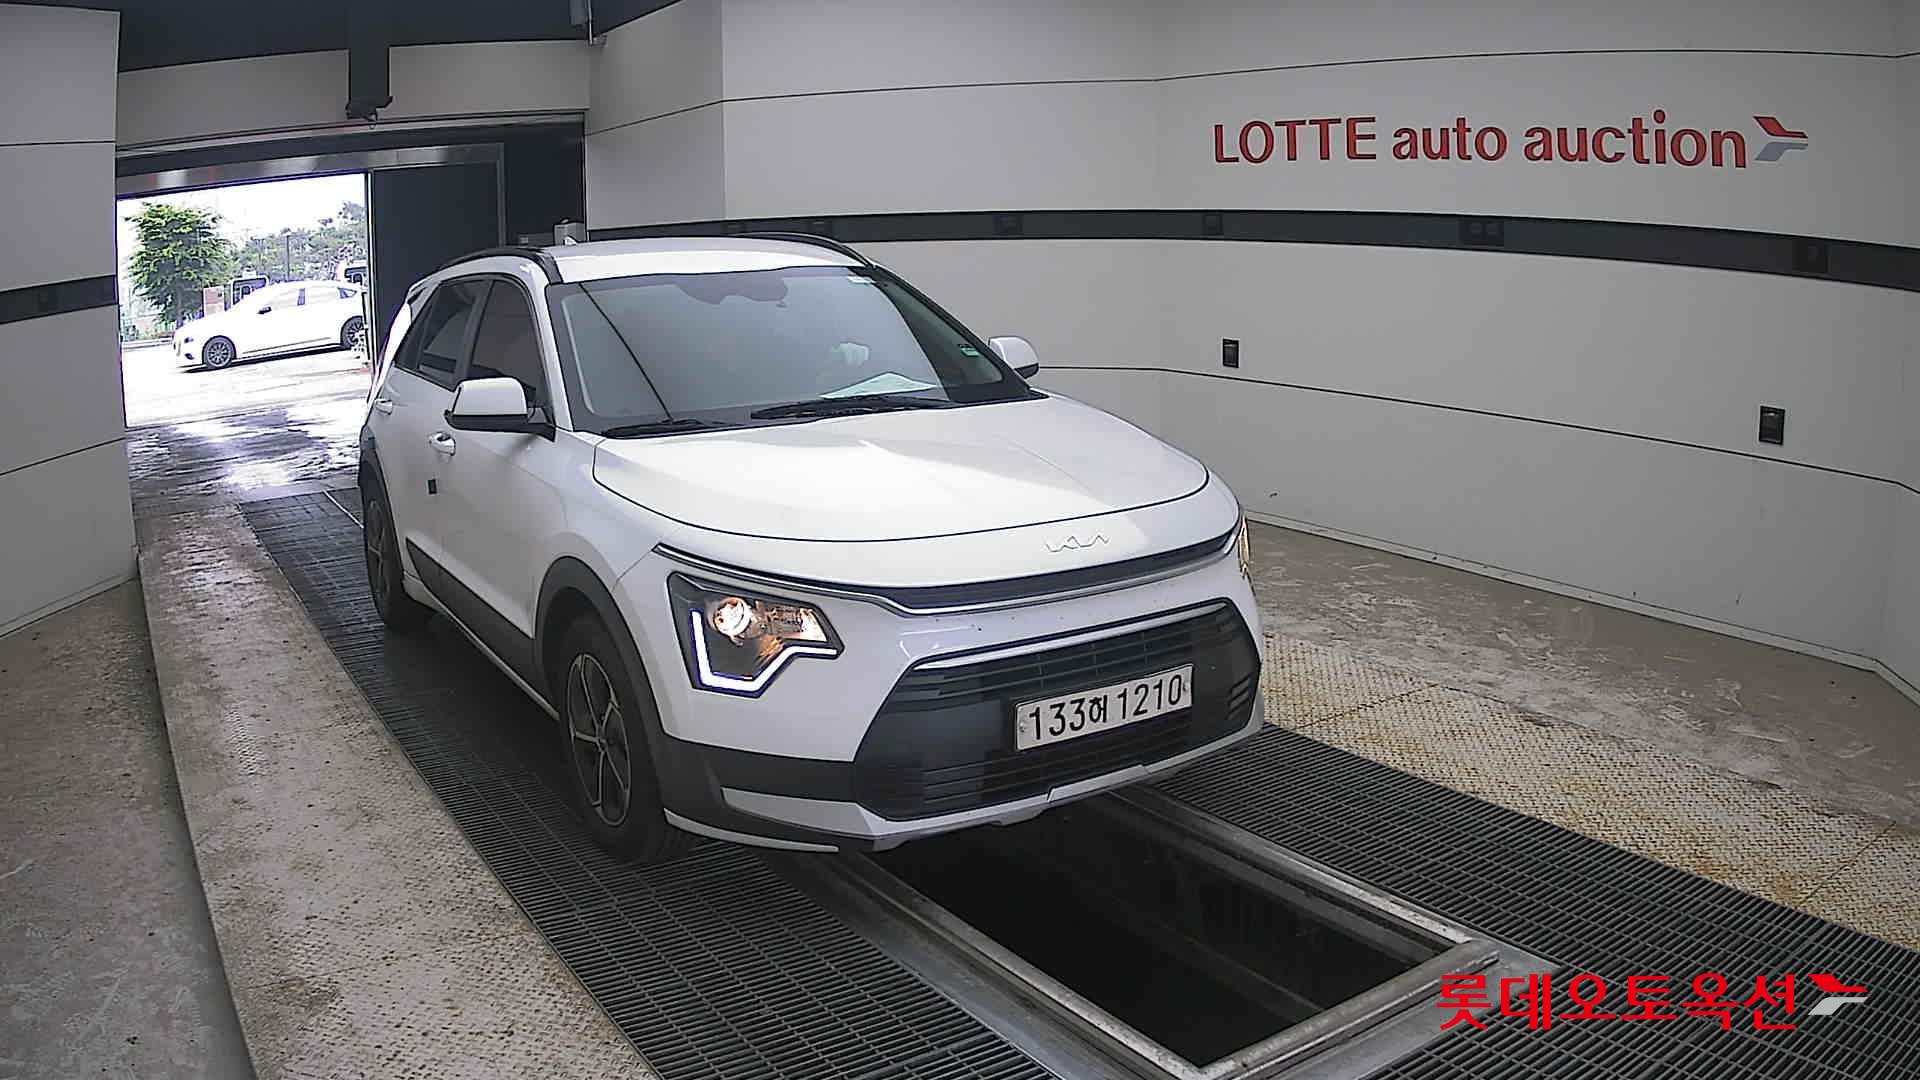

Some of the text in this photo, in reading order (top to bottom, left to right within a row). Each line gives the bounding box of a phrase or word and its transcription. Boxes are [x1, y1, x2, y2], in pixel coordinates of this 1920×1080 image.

[1213, 109, 1747, 169] LOTTE auto auction
[1028, 674, 1183, 741] 133허 1210
